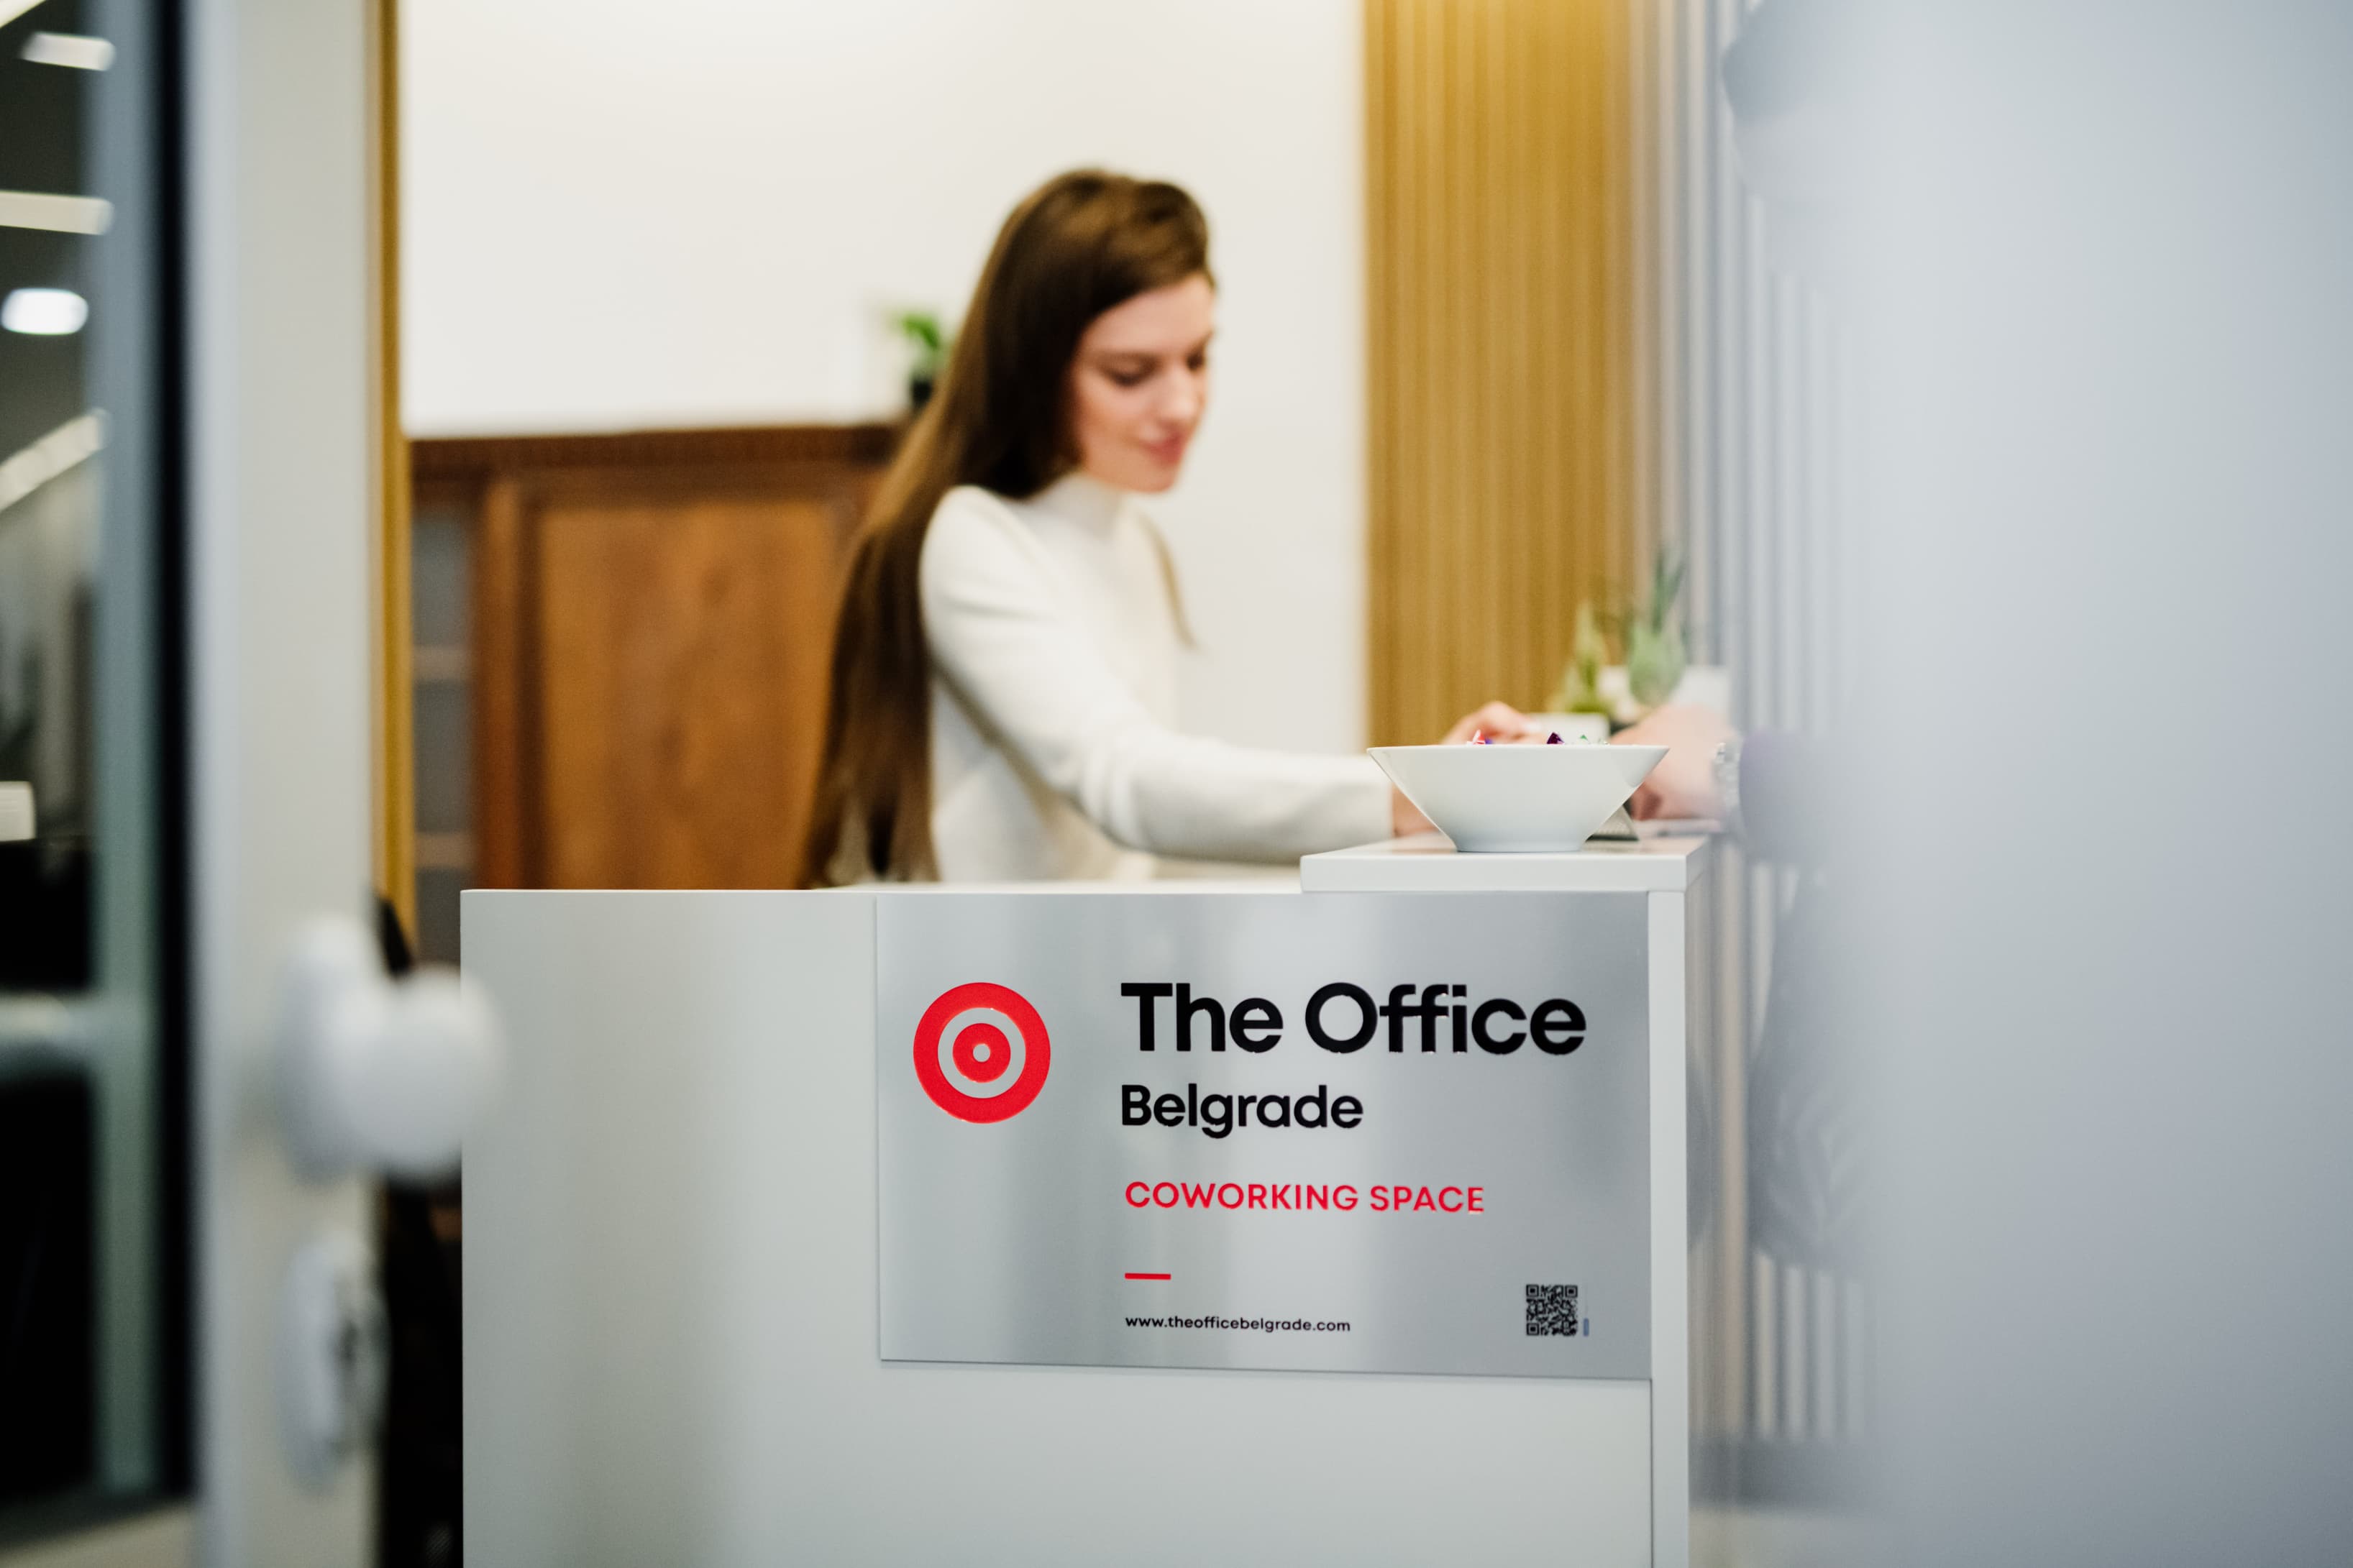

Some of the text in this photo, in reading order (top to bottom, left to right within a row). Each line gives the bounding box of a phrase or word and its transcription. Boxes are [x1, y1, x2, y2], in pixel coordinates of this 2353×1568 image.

[1121, 983, 1586, 1055] The Office
[1122, 1083, 1363, 1139] Belgrade
[1125, 1181, 1485, 1214] COWORKING SPACE
[1125, 1316, 1351, 1333] www.theofficebelgrade.com
